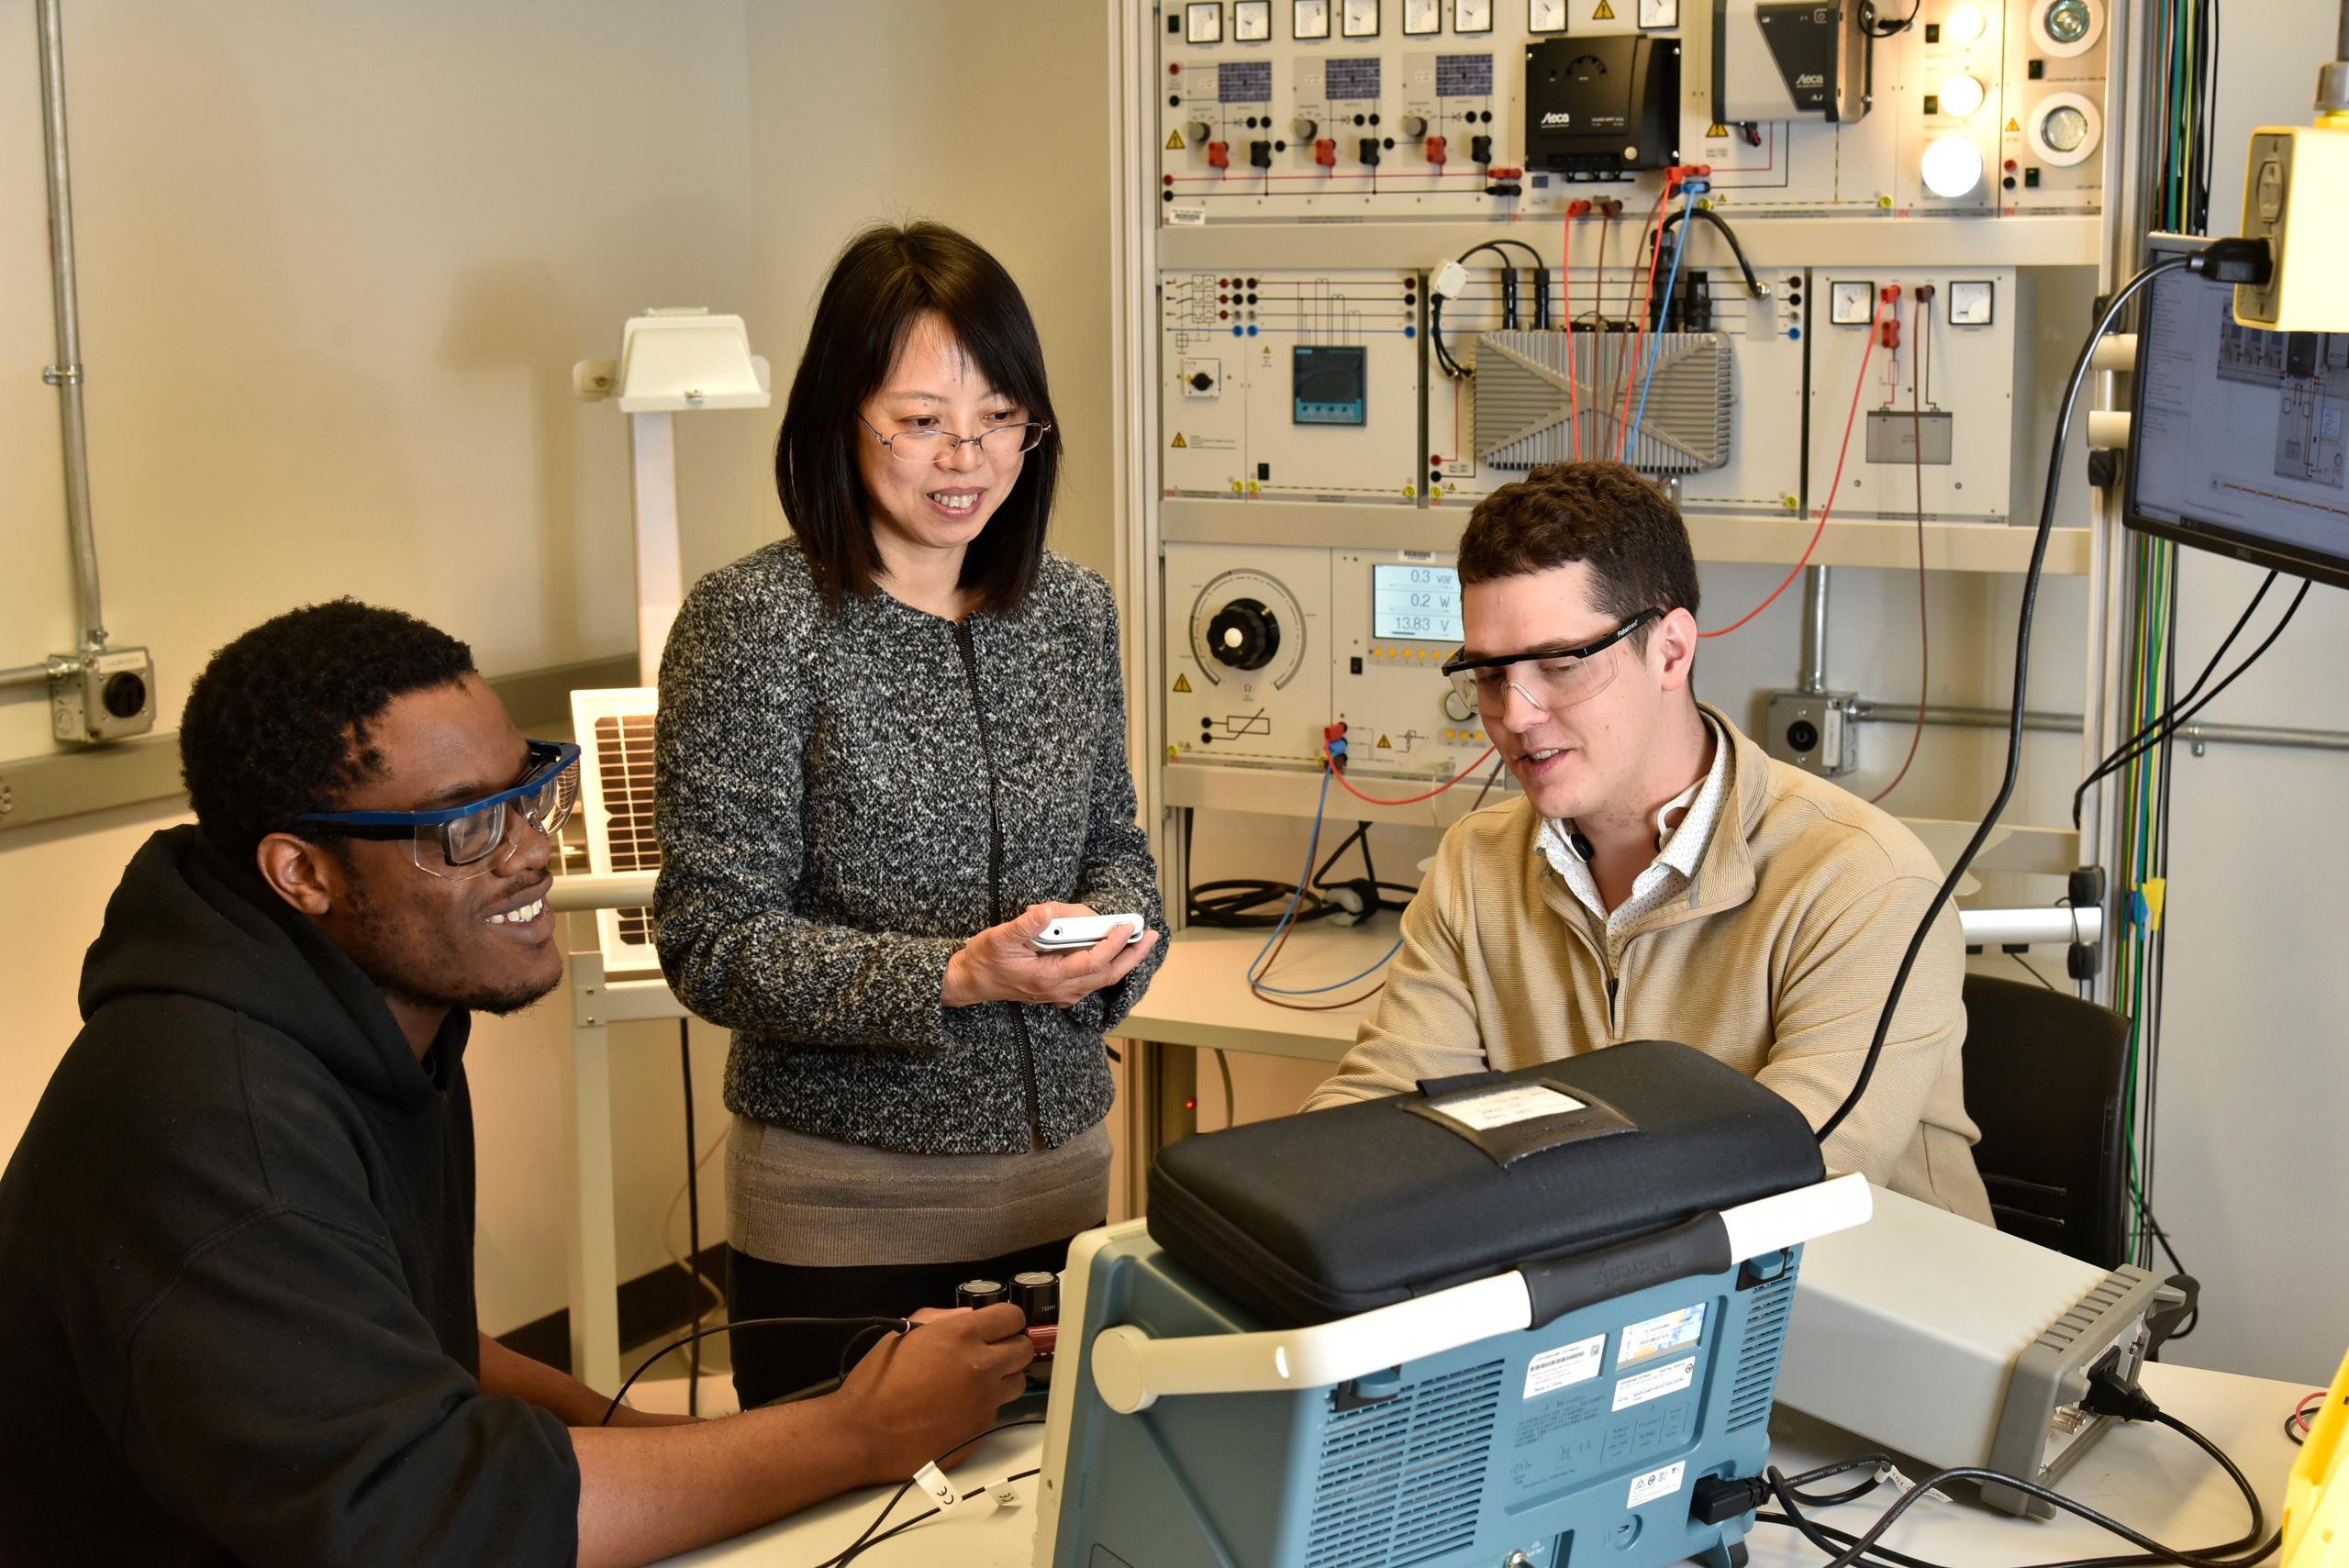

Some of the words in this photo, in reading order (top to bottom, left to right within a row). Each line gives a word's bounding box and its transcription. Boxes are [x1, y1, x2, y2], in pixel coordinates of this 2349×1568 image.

[1410, 569, 1431, 584] 0.3
[1437, 575, 1453, 584] var
[1410, 593, 1431, 607] 0.2
[1439, 595, 1451, 608] W
[1396, 617, 1431, 631] 13.83
[1440, 619, 1450, 632] V
